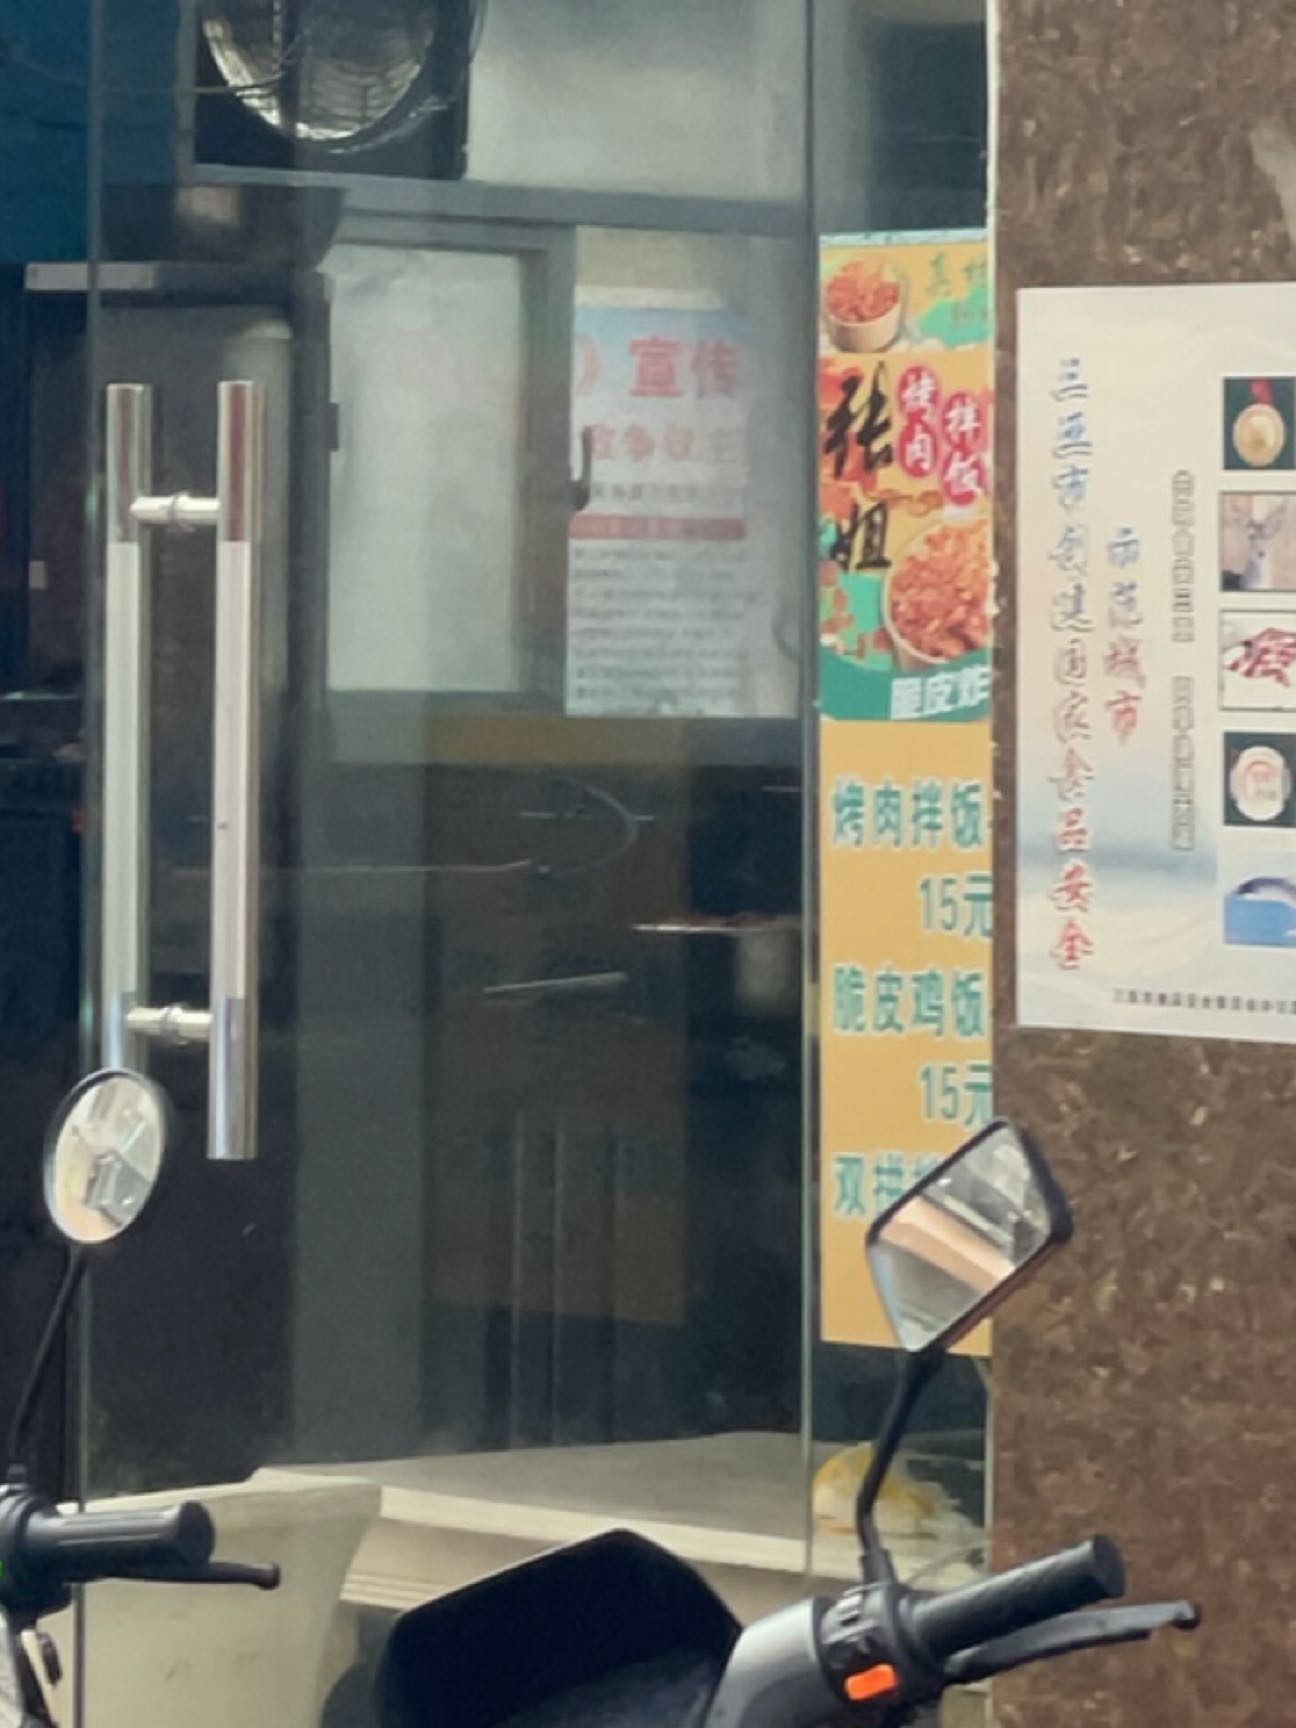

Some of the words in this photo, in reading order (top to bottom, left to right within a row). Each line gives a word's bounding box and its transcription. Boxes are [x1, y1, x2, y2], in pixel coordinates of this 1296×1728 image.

[832, 780, 985, 848] 烤肉拌饭
[920, 875, 994, 937] 15元
[834, 966, 985, 1036] 脆皮鸡饭
[920, 1065, 993, 1126] 15元
